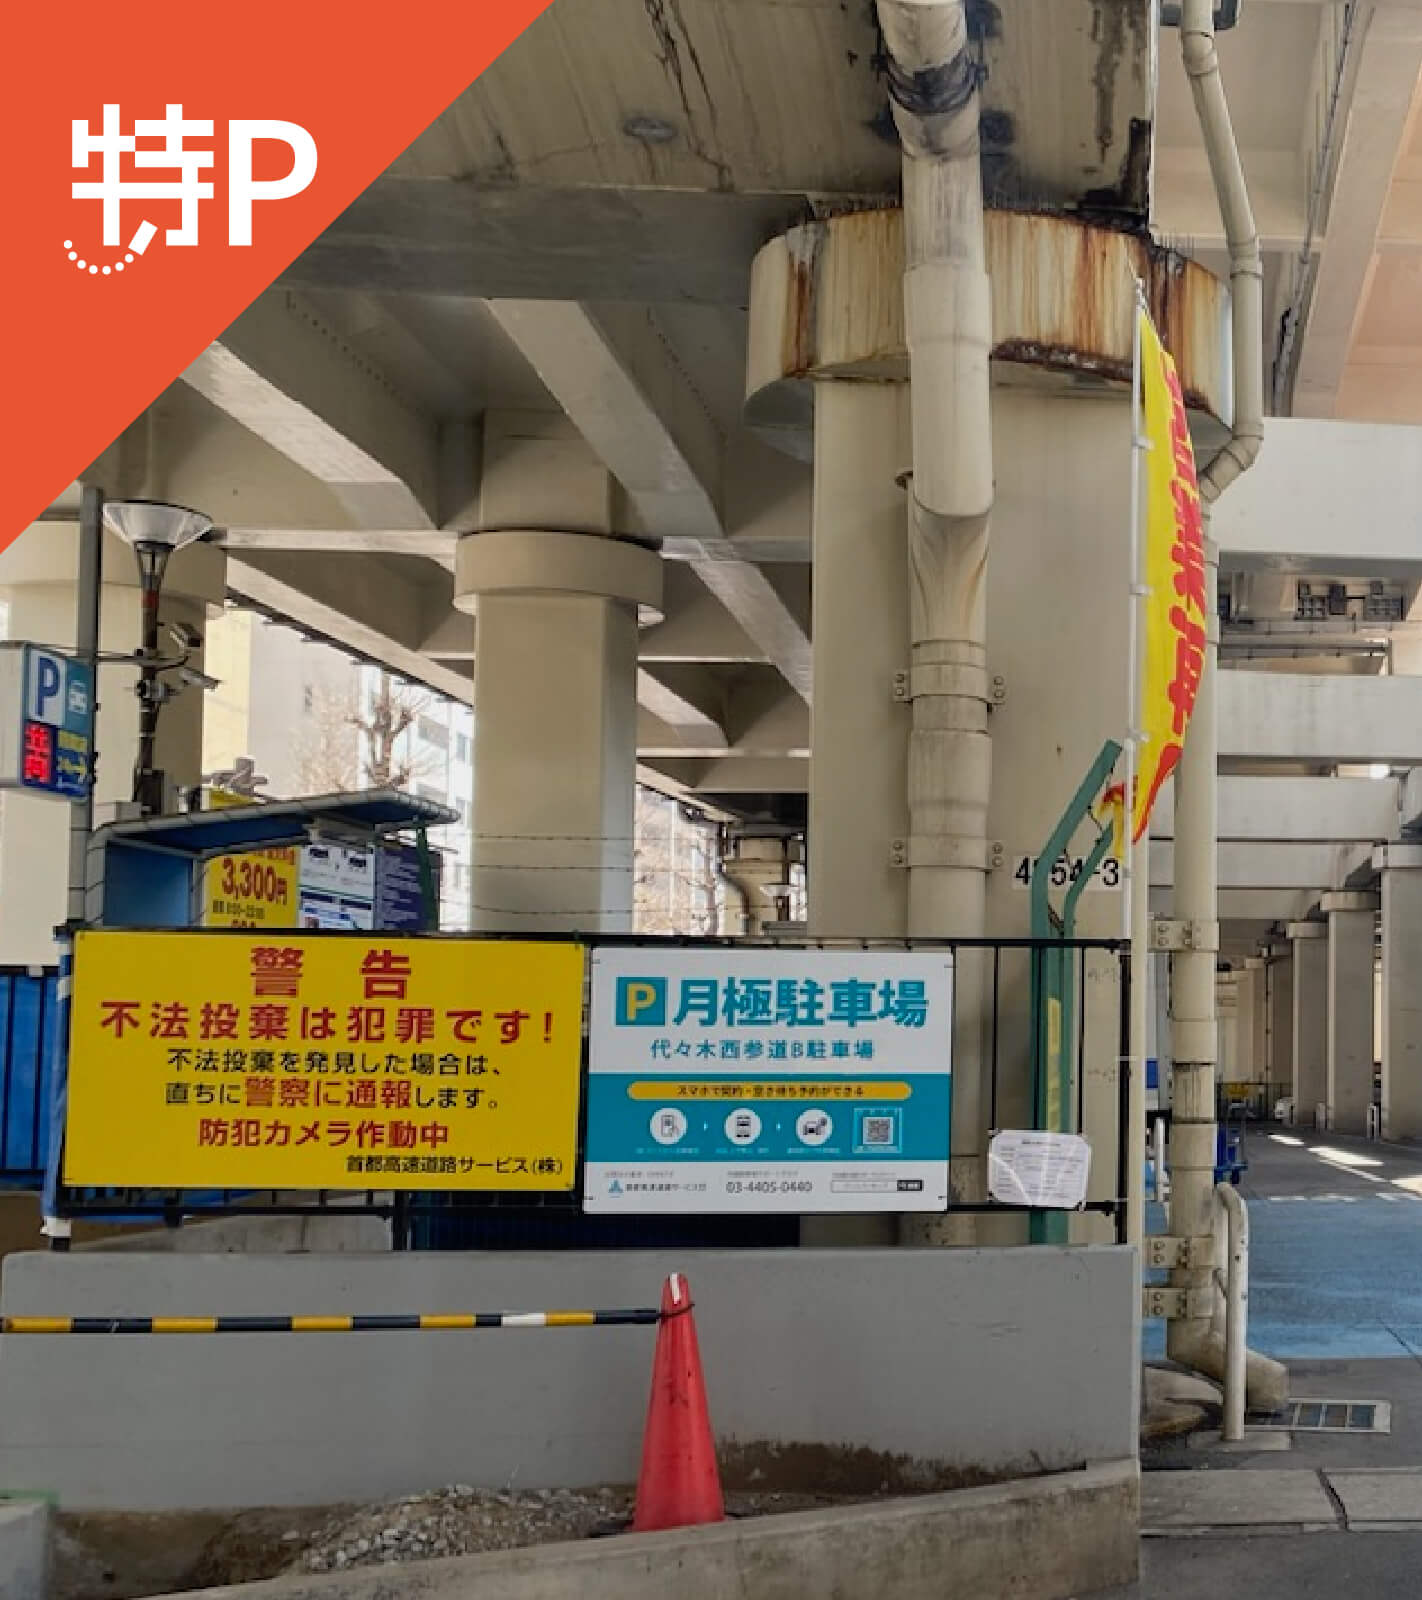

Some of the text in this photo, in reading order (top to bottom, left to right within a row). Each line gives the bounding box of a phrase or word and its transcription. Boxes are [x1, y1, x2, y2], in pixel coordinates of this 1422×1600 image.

[35, 656, 61, 717] P
[222, 858, 288, 905] 3,300円
[627, 983, 656, 1021] P
[672, 976, 930, 1029] 月極駐車場
[167, 1048, 500, 1076] 不法投棄を発見した場合は、
[651, 1039, 876, 1060] 代々木西参道B駐車場
[165, 1077, 499, 1109] 直ちに警察に通報します。
[198, 1118, 449, 1149] 防犯カメラ作動中
